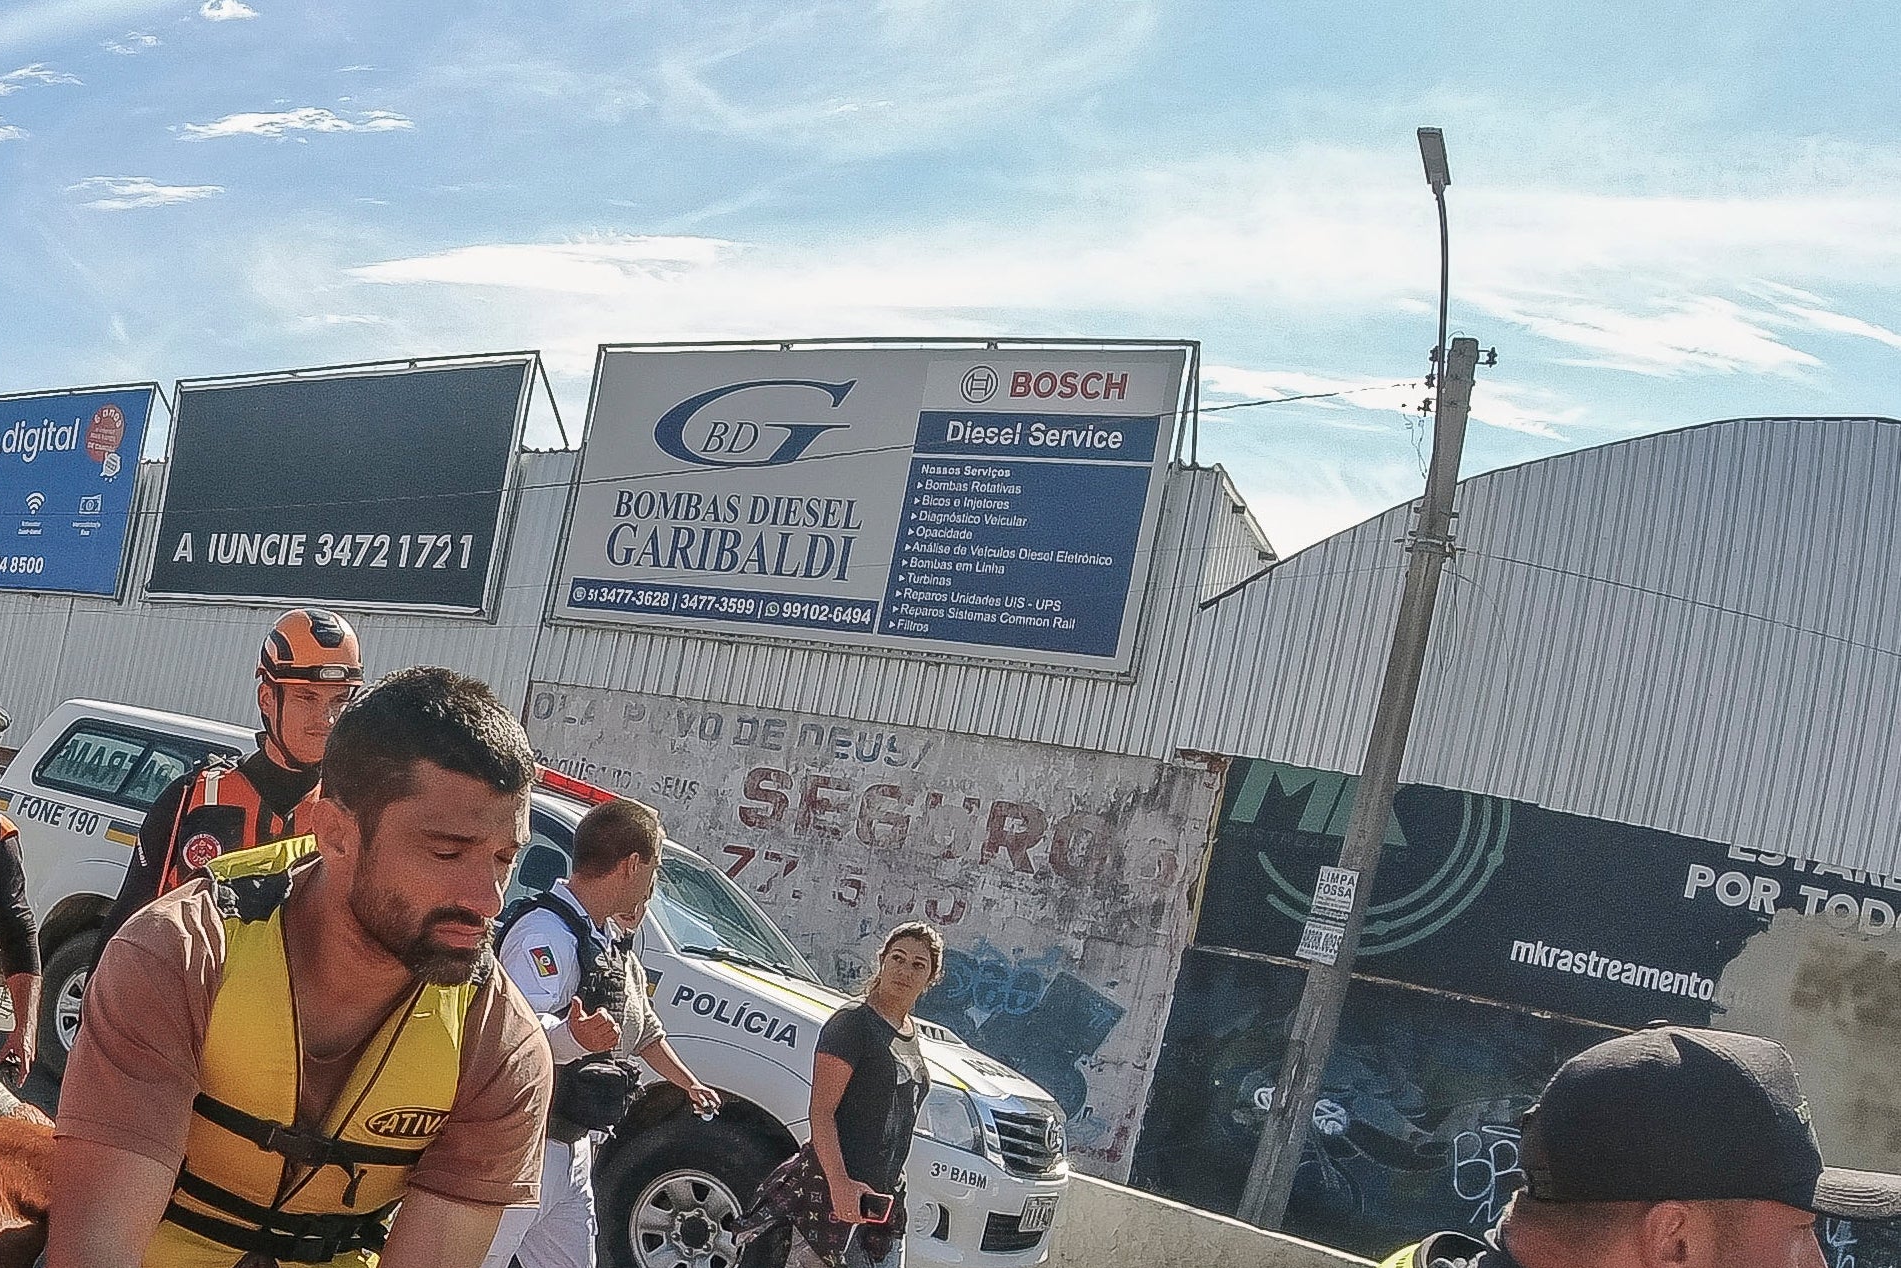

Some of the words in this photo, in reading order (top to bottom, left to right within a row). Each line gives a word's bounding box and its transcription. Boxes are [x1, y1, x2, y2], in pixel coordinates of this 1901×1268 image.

[1009, 371, 1129, 400] BOSCH
[945, 420, 1021, 446] Diesel
[1028, 422, 1124, 449] Service
[921, 464, 960, 475] Nossos
[964, 466, 1011, 478] Serviços
[925, 481, 968, 492] Bombas
[971, 482, 1022, 494] Rotativas
[612, 489, 741, 525] BOMBAS
[746, 494, 863, 531] DIESEL
[921, 495, 951, 506] Bicos
[963, 497, 1010, 511] Injetores
[918, 510, 980, 525] Diagnóstico
[984, 514, 1028, 528] Veicular
[916, 526, 973, 540] Opacidade
[605, 521, 858, 582] GARIBALDI
[911, 541, 951, 555] Análise
[953, 543, 967, 556] de
[970, 545, 1016, 560] Veículos
[1019, 548, 1053, 562] Diesel
[1056, 550, 1113, 566] Eletrônico
[9, 556, 44, 574] 8500
[909, 557, 952, 571] Bombas
[955, 562, 972, 573] em
[975, 559, 1005, 575] Linha
[906, 573, 952, 587] Turbinas
[599, 587, 670, 608] 3477-3628
[680, 589, 755, 616] 3477-3599
[782, 601, 872, 625] 99102-6494
[903, 588, 948, 603] Reparos
[951, 591, 1001, 607] Unidades
[1004, 596, 1025, 609] UIS
[1036, 598, 1062, 612] UPS
[897, 620, 929, 633] Filtros
[900, 604, 945, 619] Reparos
[948, 607, 997, 623] Sistemas
[1000, 611, 1050, 627] Common
[1053, 615, 1076, 630] Rail
[17, 796, 66, 827] FONE
[68, 811, 99, 836] 190
[1317, 882, 1353, 899] FOSSA
[1319, 870, 1356, 888] LIMPA
[1683, 863, 1782, 915] POR
[1798, 884, 1901, 936] TOD
[670, 984, 798, 1049] POLÍCIA
[950, 1166, 987, 1190] BABM
